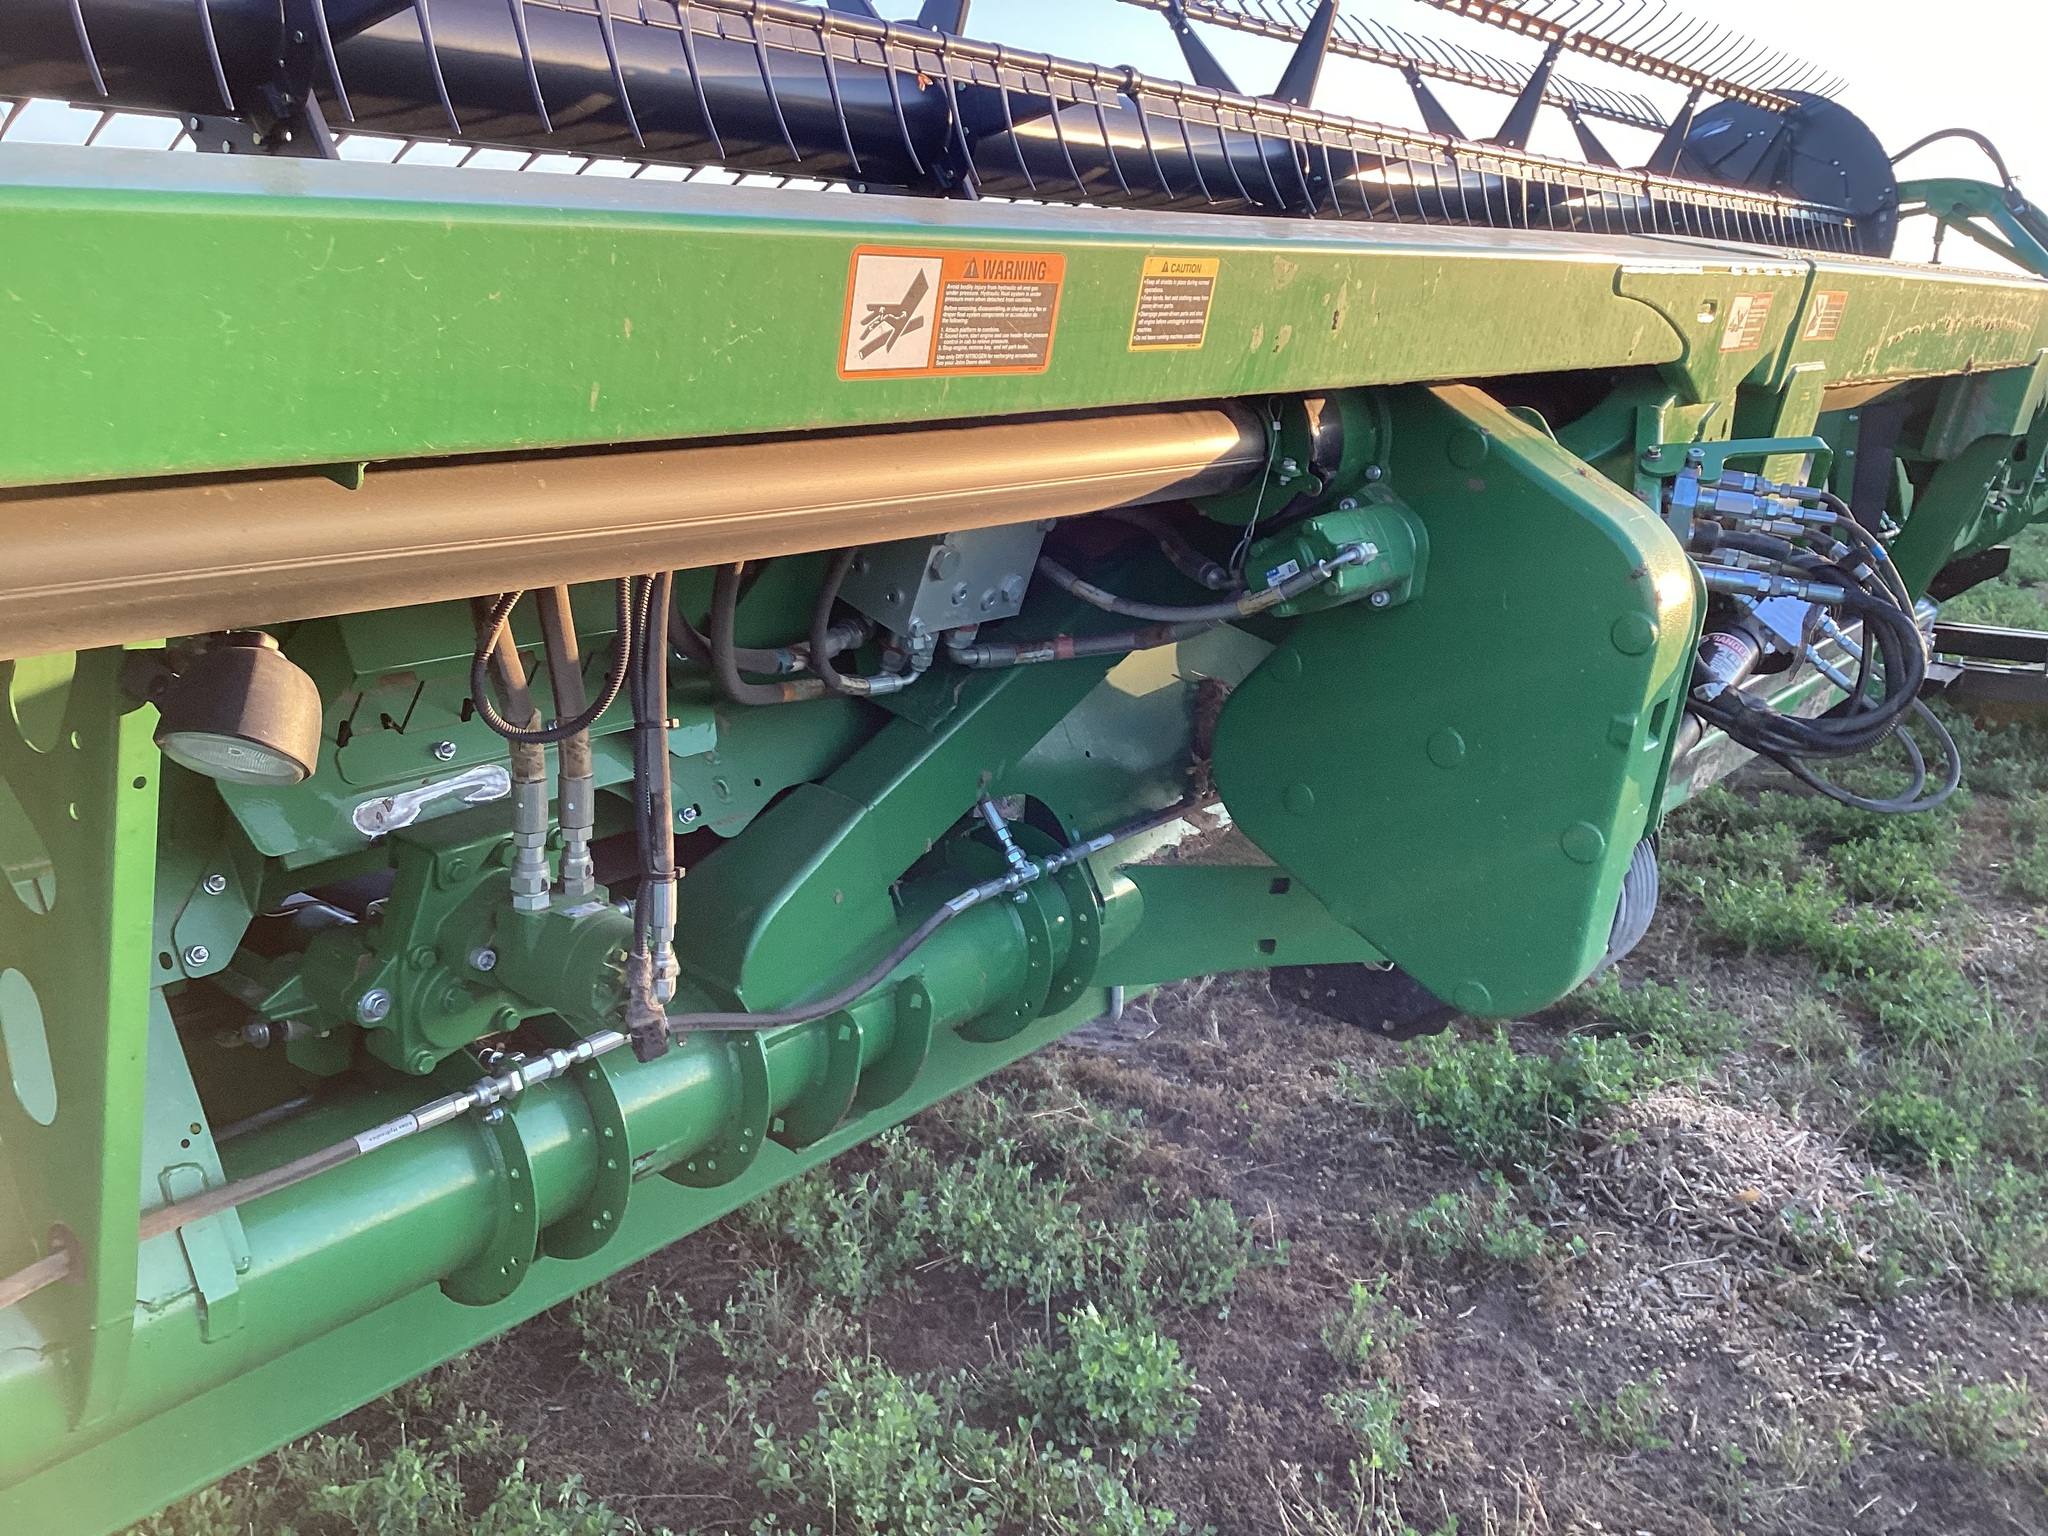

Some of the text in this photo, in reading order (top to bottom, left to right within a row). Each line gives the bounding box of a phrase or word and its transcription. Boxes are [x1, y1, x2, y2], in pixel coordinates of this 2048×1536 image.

[983, 259, 1047, 280] WARNING
[1171, 264, 1202, 273] CAUTION
[1713, 636, 1749, 663] DANGER
